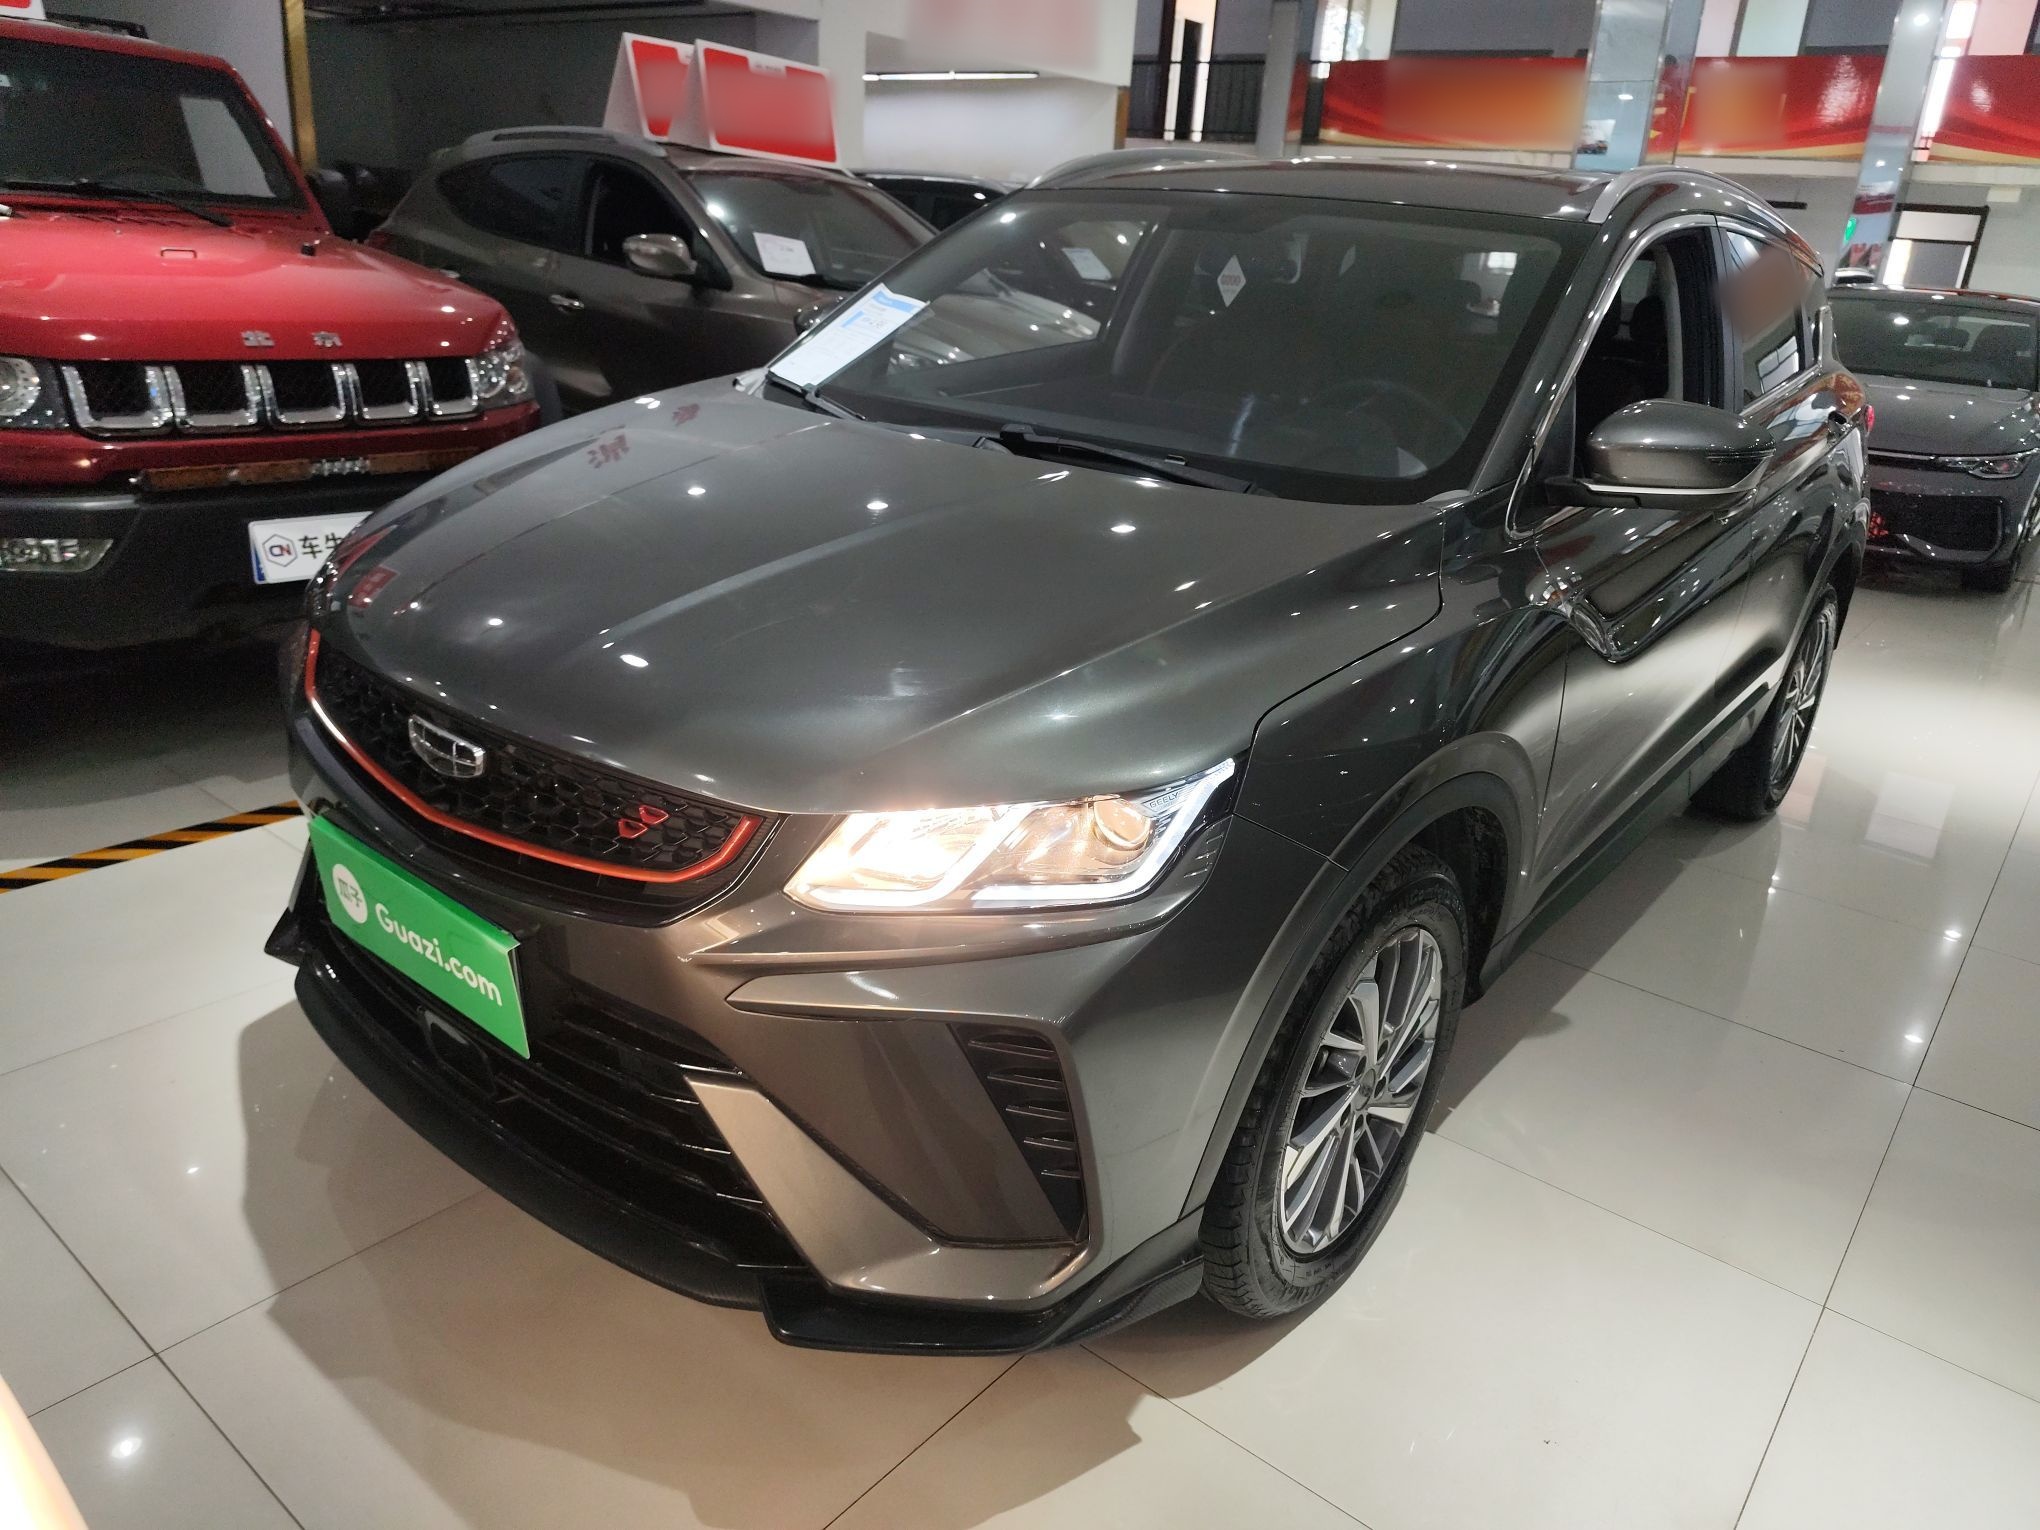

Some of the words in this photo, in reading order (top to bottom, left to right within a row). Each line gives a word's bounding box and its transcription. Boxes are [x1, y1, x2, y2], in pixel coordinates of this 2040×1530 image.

[1149, 791, 1179, 808] GEELY
[337, 878, 362, 908] 瓜子
[375, 902, 503, 1007] Guazi.com
